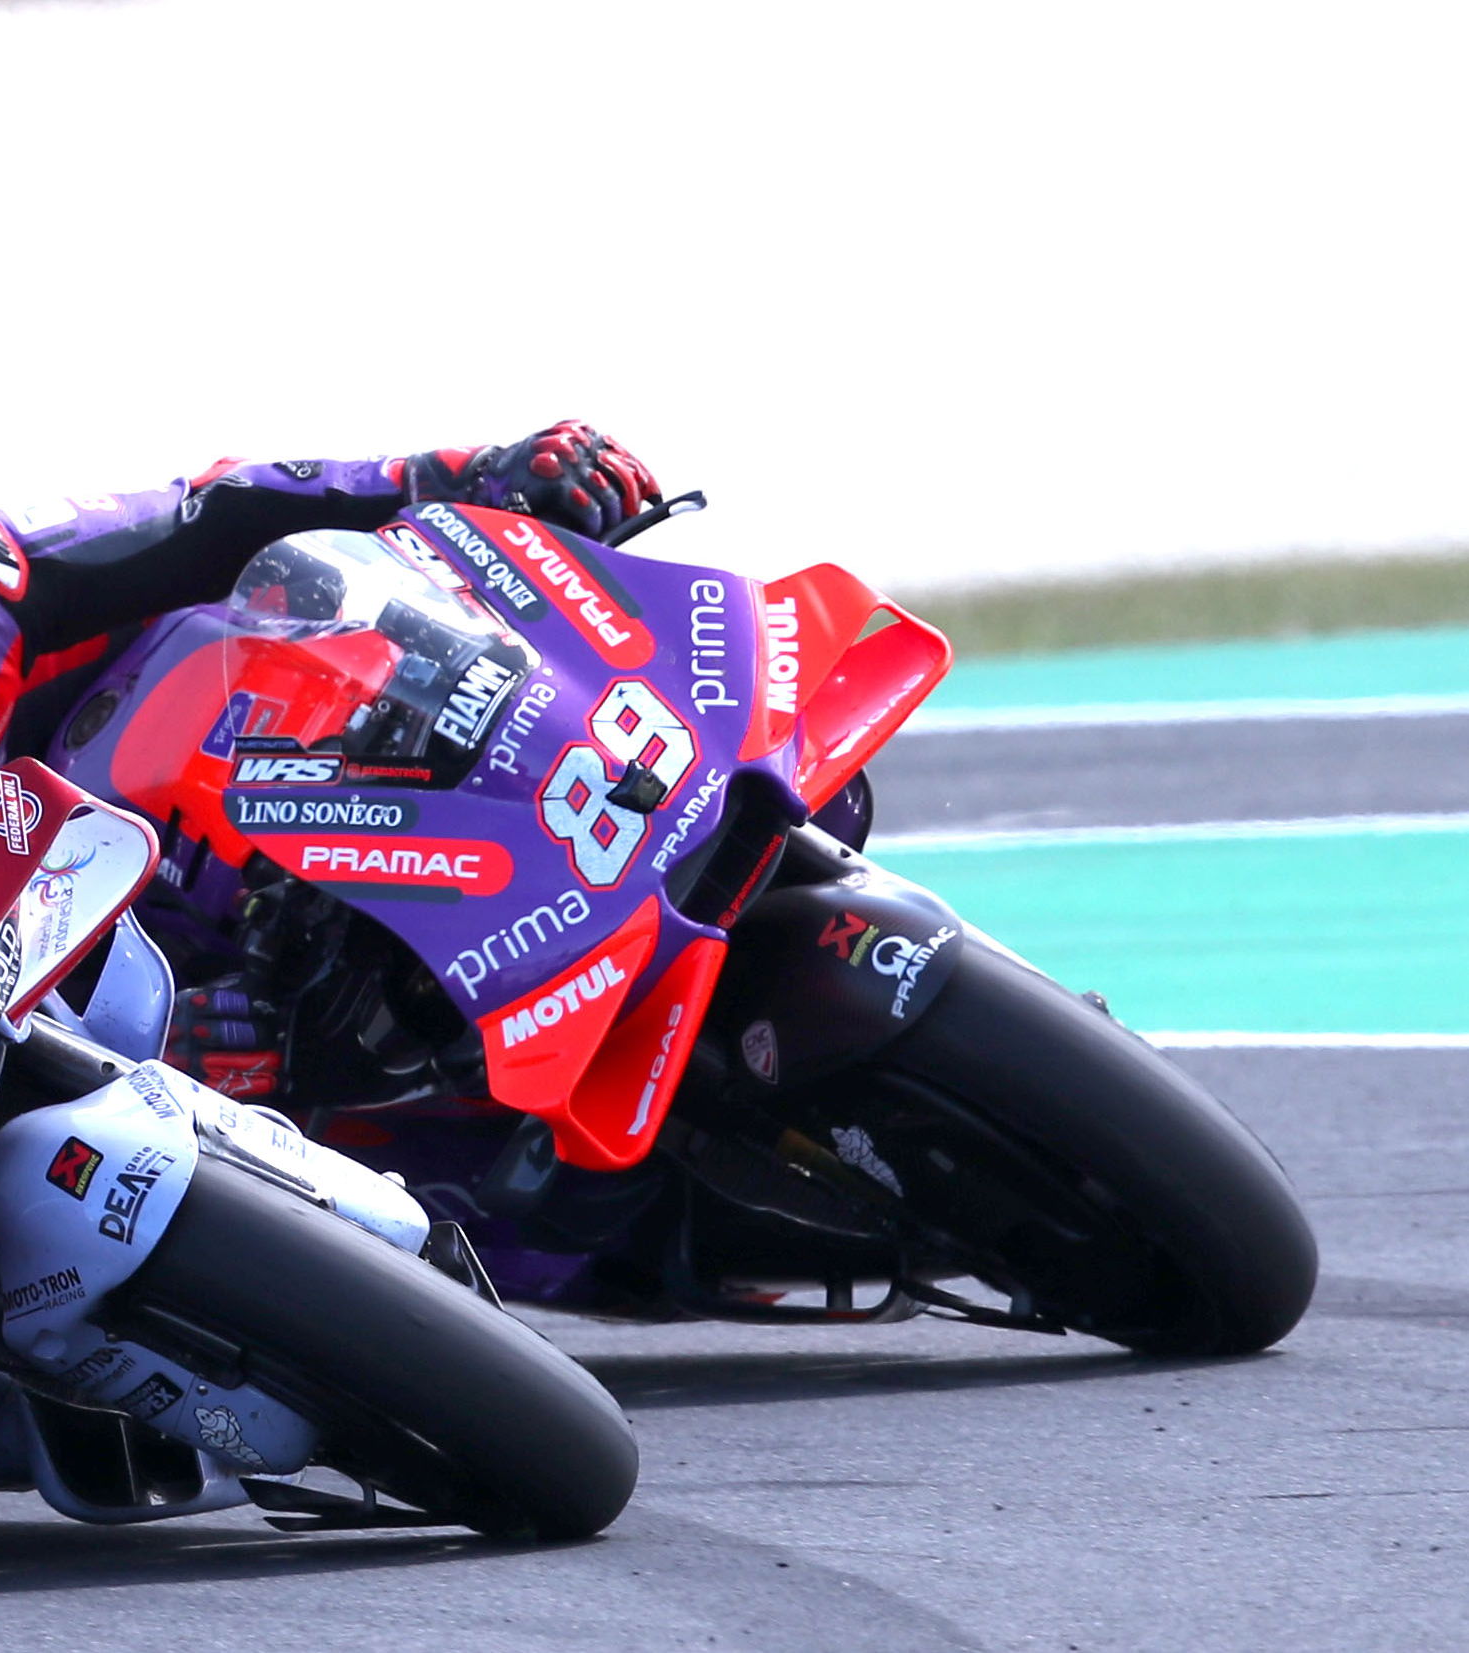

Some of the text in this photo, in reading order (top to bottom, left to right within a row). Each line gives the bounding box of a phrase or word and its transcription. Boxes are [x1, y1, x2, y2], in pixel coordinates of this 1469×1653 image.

[422, 503, 537, 610] LINO SONEGO
[503, 521, 632, 648] PRAMAC
[690, 579, 738, 715] prima
[766, 597, 799, 714] MOTUL
[434, 656, 512, 748] FIAMM
[488, 683, 557, 775] prima
[4, 778, 25, 850] FEDERAL OIL
[235, 758, 340, 782] WRS
[238, 800, 403, 827] LINO SONEGO
[535, 676, 702, 891] 89
[301, 846, 480, 879] PRAMAC
[651, 768, 727, 873] PRAMAC
[445, 889, 592, 1000] prima
[891, 926, 957, 1019] PRAMAC
[501, 956, 627, 1049] MOTUL
[2, 1267, 81, 1312] MOTO-TRON
[42, 1286, 87, 1313] RACING
